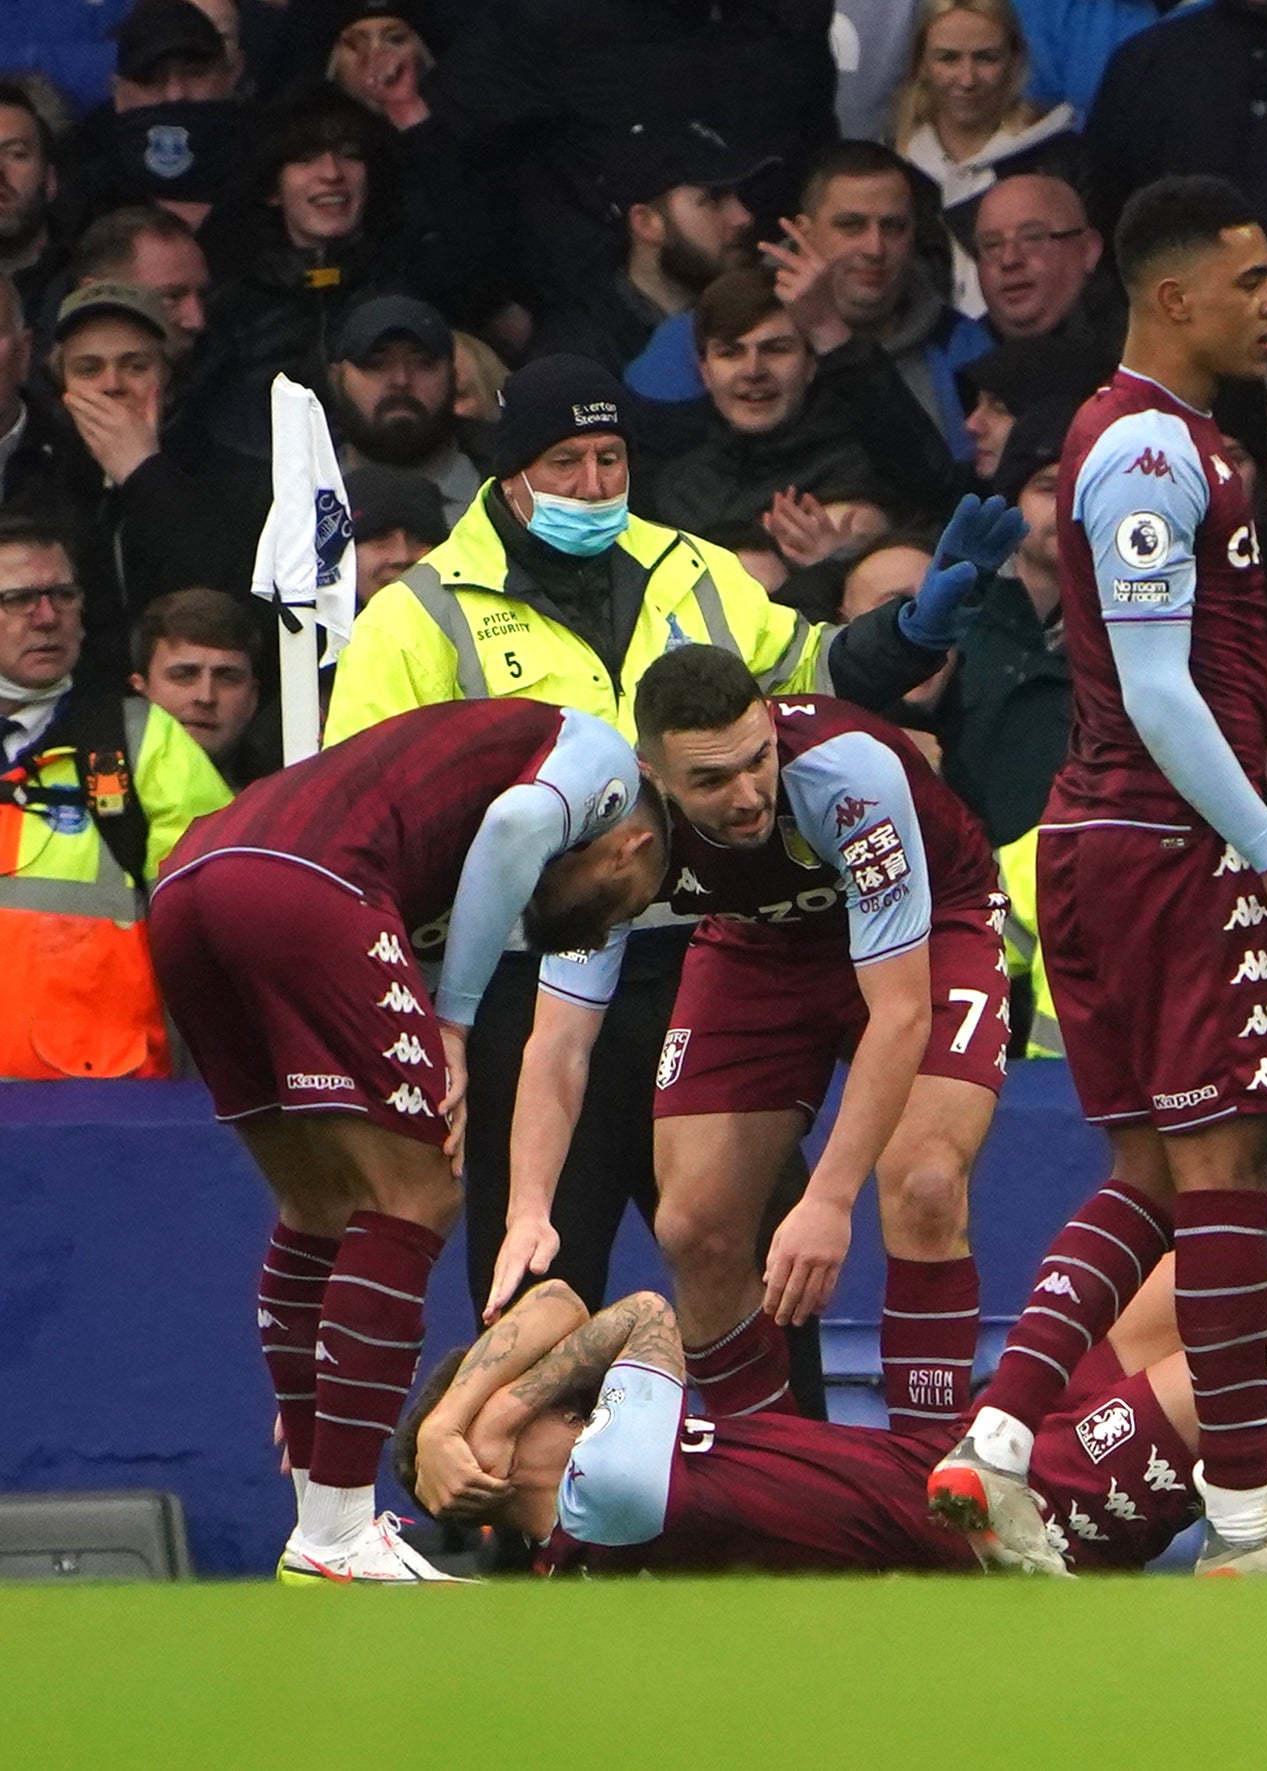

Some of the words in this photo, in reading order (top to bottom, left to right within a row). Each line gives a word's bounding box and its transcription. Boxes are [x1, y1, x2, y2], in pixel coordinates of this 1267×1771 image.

[1114, 579, 1131, 594] No
[1133, 581, 1167, 594] room
[483, 611, 517, 626] PITCH
[477, 623, 530, 641] SECURITY
[504, 651, 522, 678] 5
[949, 988, 989, 1055] 7
[287, 1073, 355, 1090] Kappa
[1153, 1084, 1218, 1110] Kappa
[909, 1370, 953, 1388] ASTON
[908, 1386, 954, 1406] VILLA
